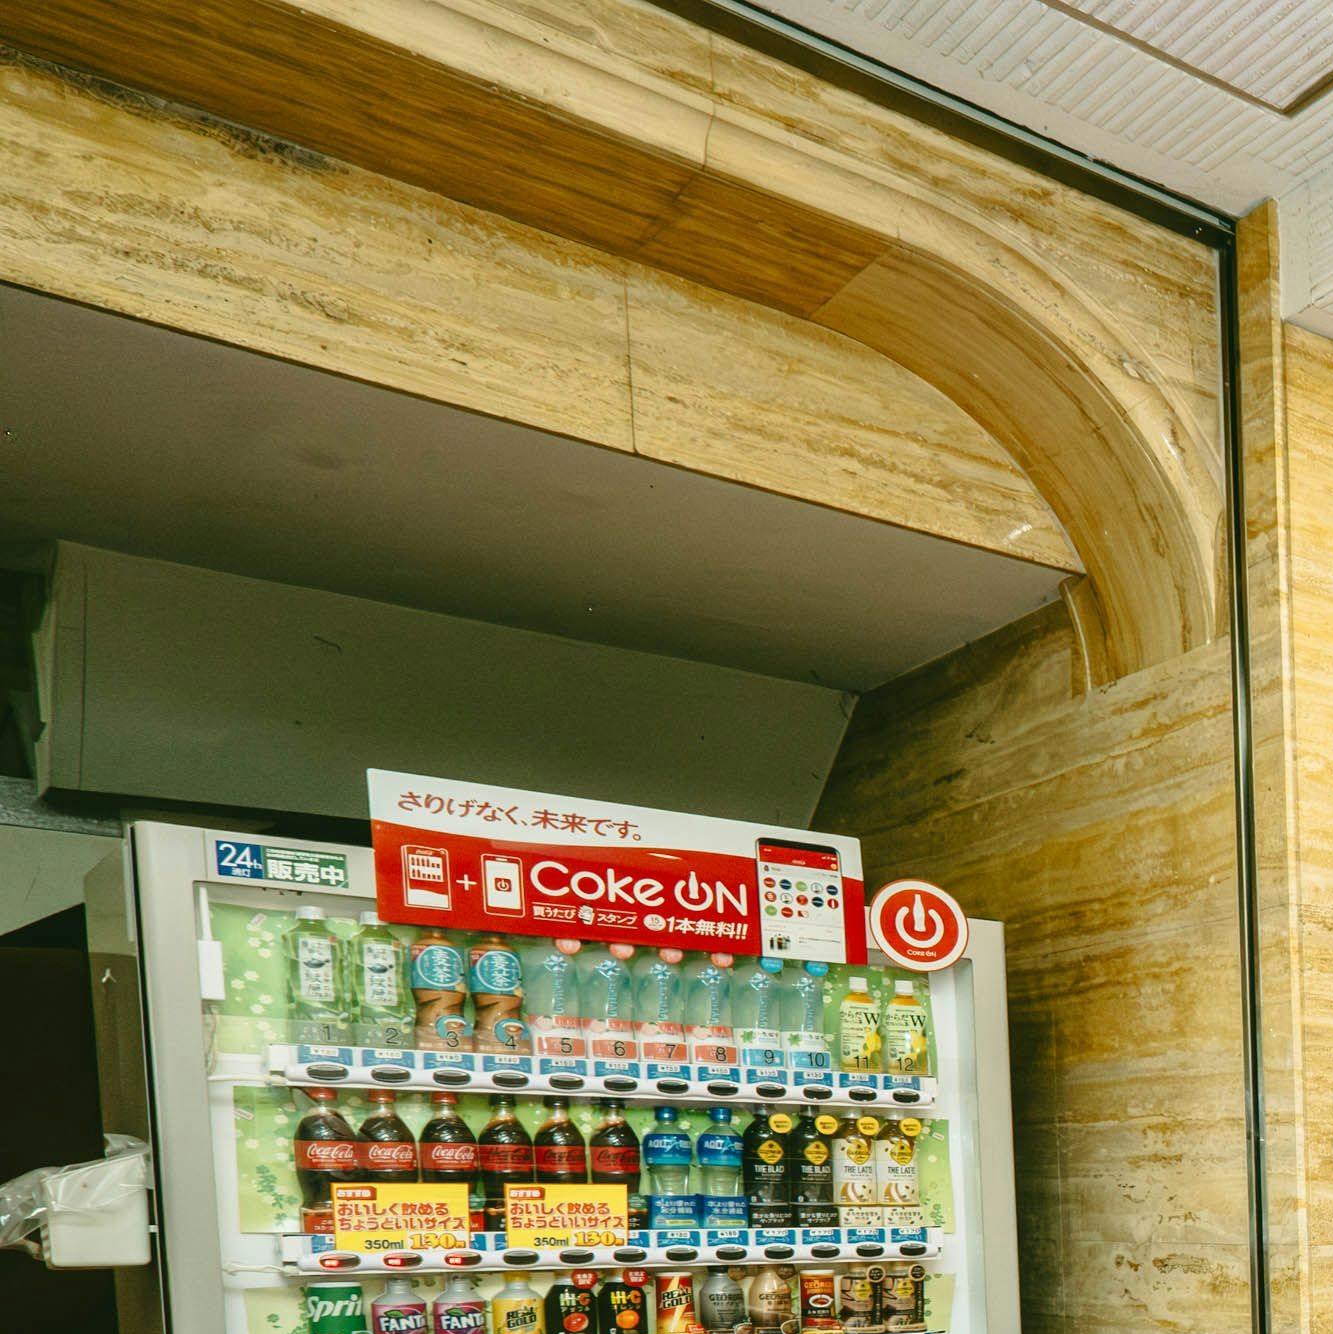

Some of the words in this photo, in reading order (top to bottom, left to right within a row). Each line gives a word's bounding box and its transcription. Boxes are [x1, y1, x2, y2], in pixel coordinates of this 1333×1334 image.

[398, 791, 642, 842] さりげなく、未来です。
[266, 859, 345, 885] 販売中
[530, 860, 665, 907] Coke
[597, 913, 637, 925] スタンプ
[320, 1025, 331, 1041] 1
[385, 1027, 400, 1044] 2
[446, 1031, 460, 1048] 3
[504, 1034, 517, 1049] 4
[561, 1038, 573, 1053] 5
[614, 1041, 626, 1057] 6
[665, 1044, 676, 1059] 7
[715, 1047, 727, 1062] 8
[764, 1049, 775, 1065] 9
[807, 1052, 825, 1067] 10
[855, 1055, 869, 1069] 11
[897, 1057, 914, 1072] 12
[337, 1203, 449, 1217] おいしく飲める
[510, 1203, 610, 1216] おいしく飲める
[364, 1239, 404, 1250] 350ml
[534, 1237, 569, 1247] 350ml
